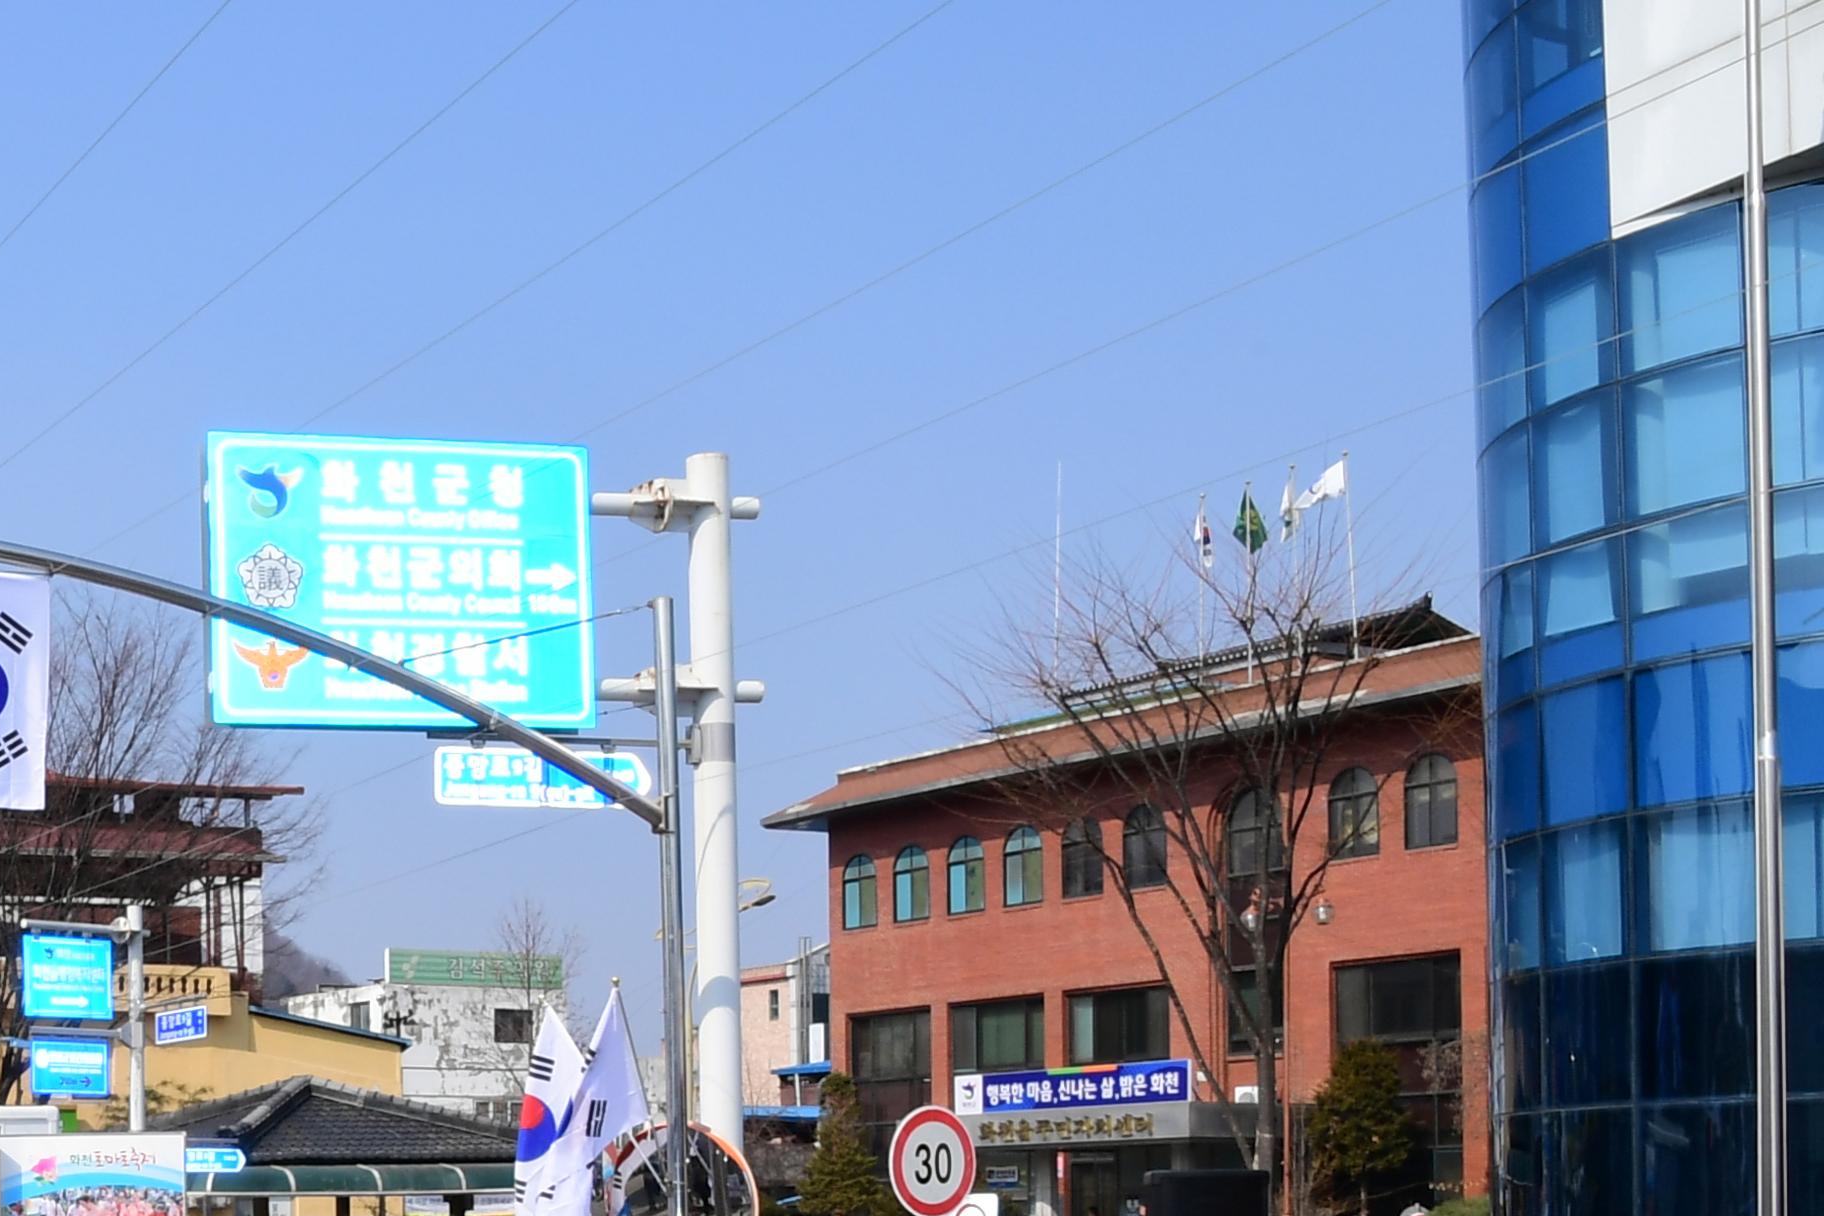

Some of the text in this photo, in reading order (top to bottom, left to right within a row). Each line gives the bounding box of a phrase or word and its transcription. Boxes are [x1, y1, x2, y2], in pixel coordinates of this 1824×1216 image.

[986, 1083, 1025, 1106] 행복한
[1149, 1071, 1180, 1095] 화천
[914, 1143, 952, 1185] 30
